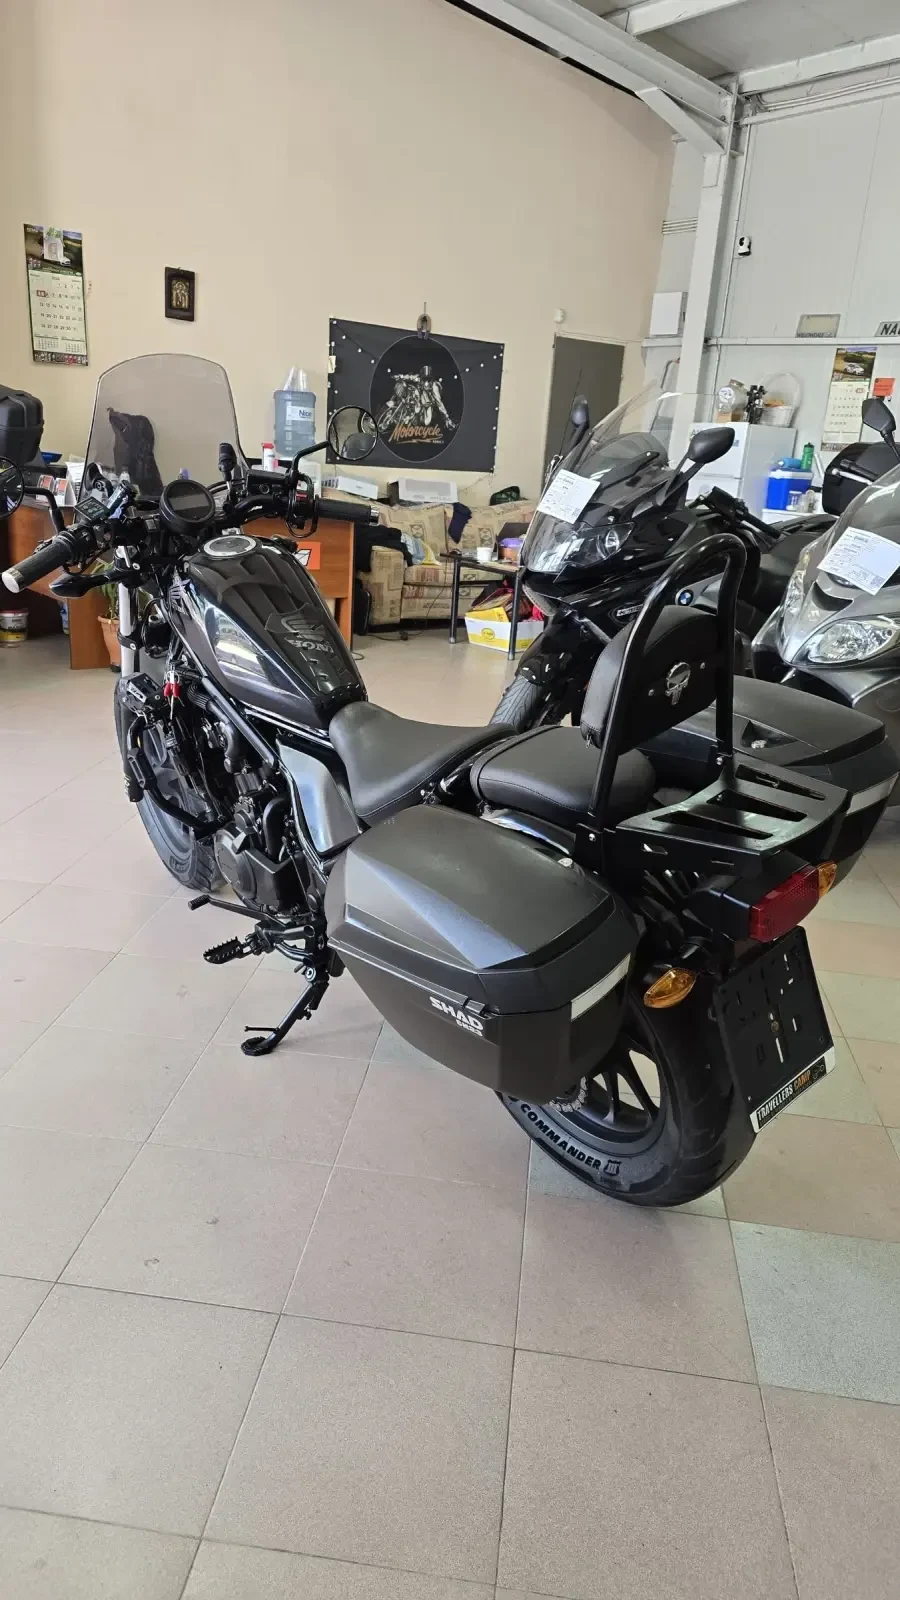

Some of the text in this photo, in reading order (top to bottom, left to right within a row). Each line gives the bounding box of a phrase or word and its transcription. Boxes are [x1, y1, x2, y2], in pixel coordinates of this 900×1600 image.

[388, 422, 444, 443] Motorcycle
[429, 996, 484, 1030] SHAD
[757, 1084, 794, 1121] TRAVELLERS
[793, 1069, 811, 1091] CAMP
[520, 1103, 601, 1170] COMMANDER
